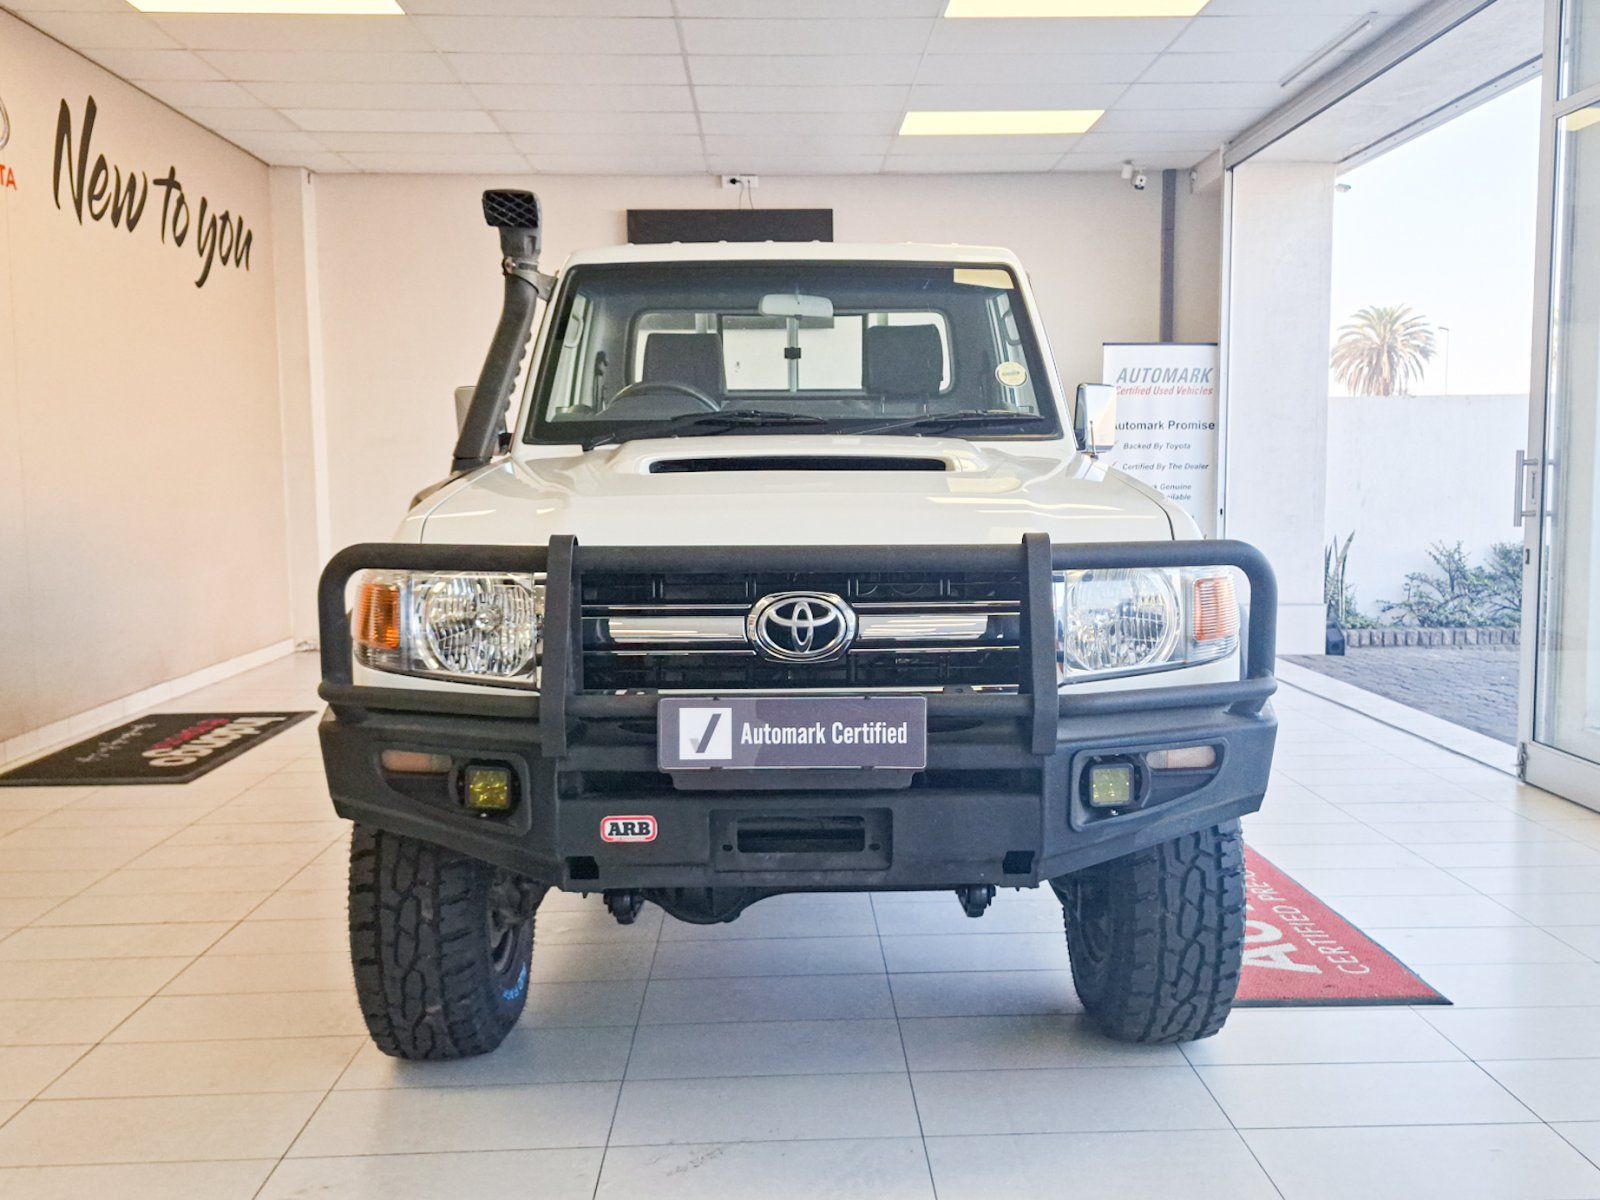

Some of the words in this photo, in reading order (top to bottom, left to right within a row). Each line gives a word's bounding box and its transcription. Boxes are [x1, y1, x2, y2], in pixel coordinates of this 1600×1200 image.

[53, 94, 148, 233] New
[153, 165, 190, 248] to
[194, 196, 253, 289] you
[1116, 367, 1213, 383] AUTOMARK
[1153, 385, 1174, 395] Used
[1176, 385, 1213, 395] Vehicles
[1115, 420, 1164, 430] utomark
[1168, 420, 1215, 430] Promise
[1123, 442, 1151, 450] Backed
[1153, 442, 1163, 451] By
[1165, 442, 1191, 451] Toyota
[1156, 463, 1165, 471] By
[741, 722, 826, 745] Automark
[831, 721, 908, 745] Certified
[608, 821, 651, 836] ARB
[1272, 905, 1370, 975] CERTIFIED
